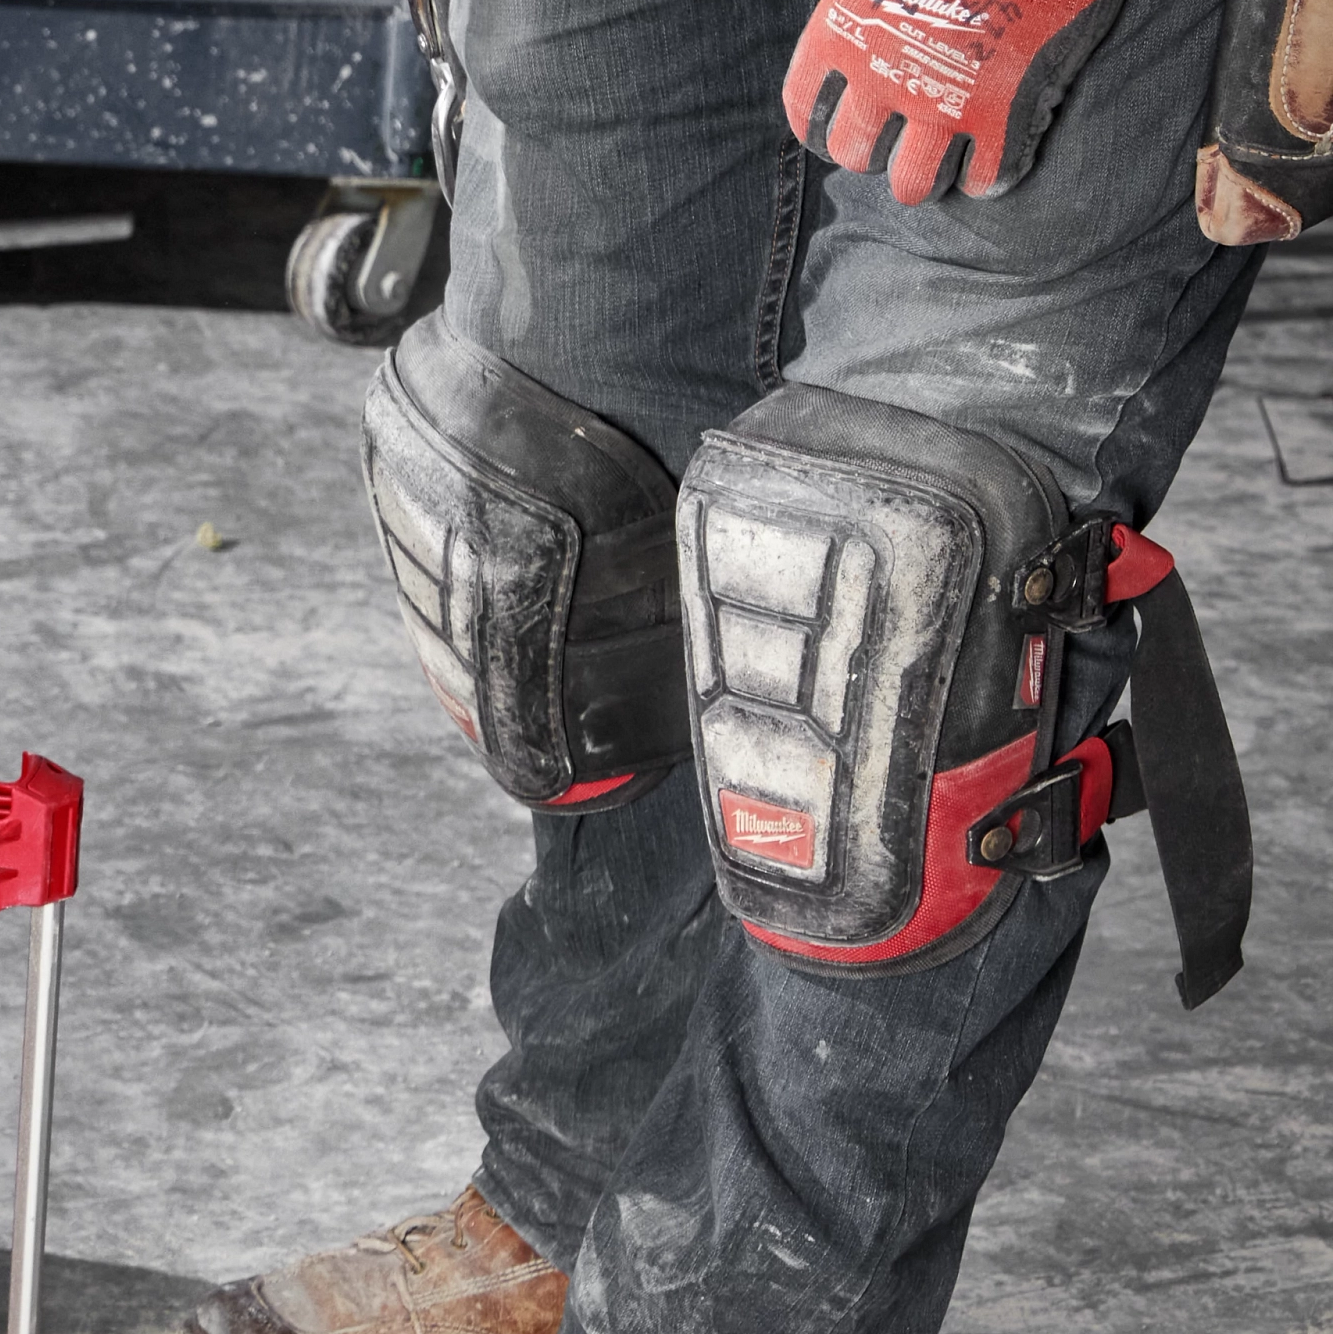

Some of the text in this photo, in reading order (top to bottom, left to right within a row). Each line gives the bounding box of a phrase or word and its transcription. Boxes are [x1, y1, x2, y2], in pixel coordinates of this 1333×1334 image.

[899, 22, 981, 70] CUT LEVEL 3
[1033, 640, 1045, 701] Milwaukee
[731, 808, 804, 834] Milwaukee
